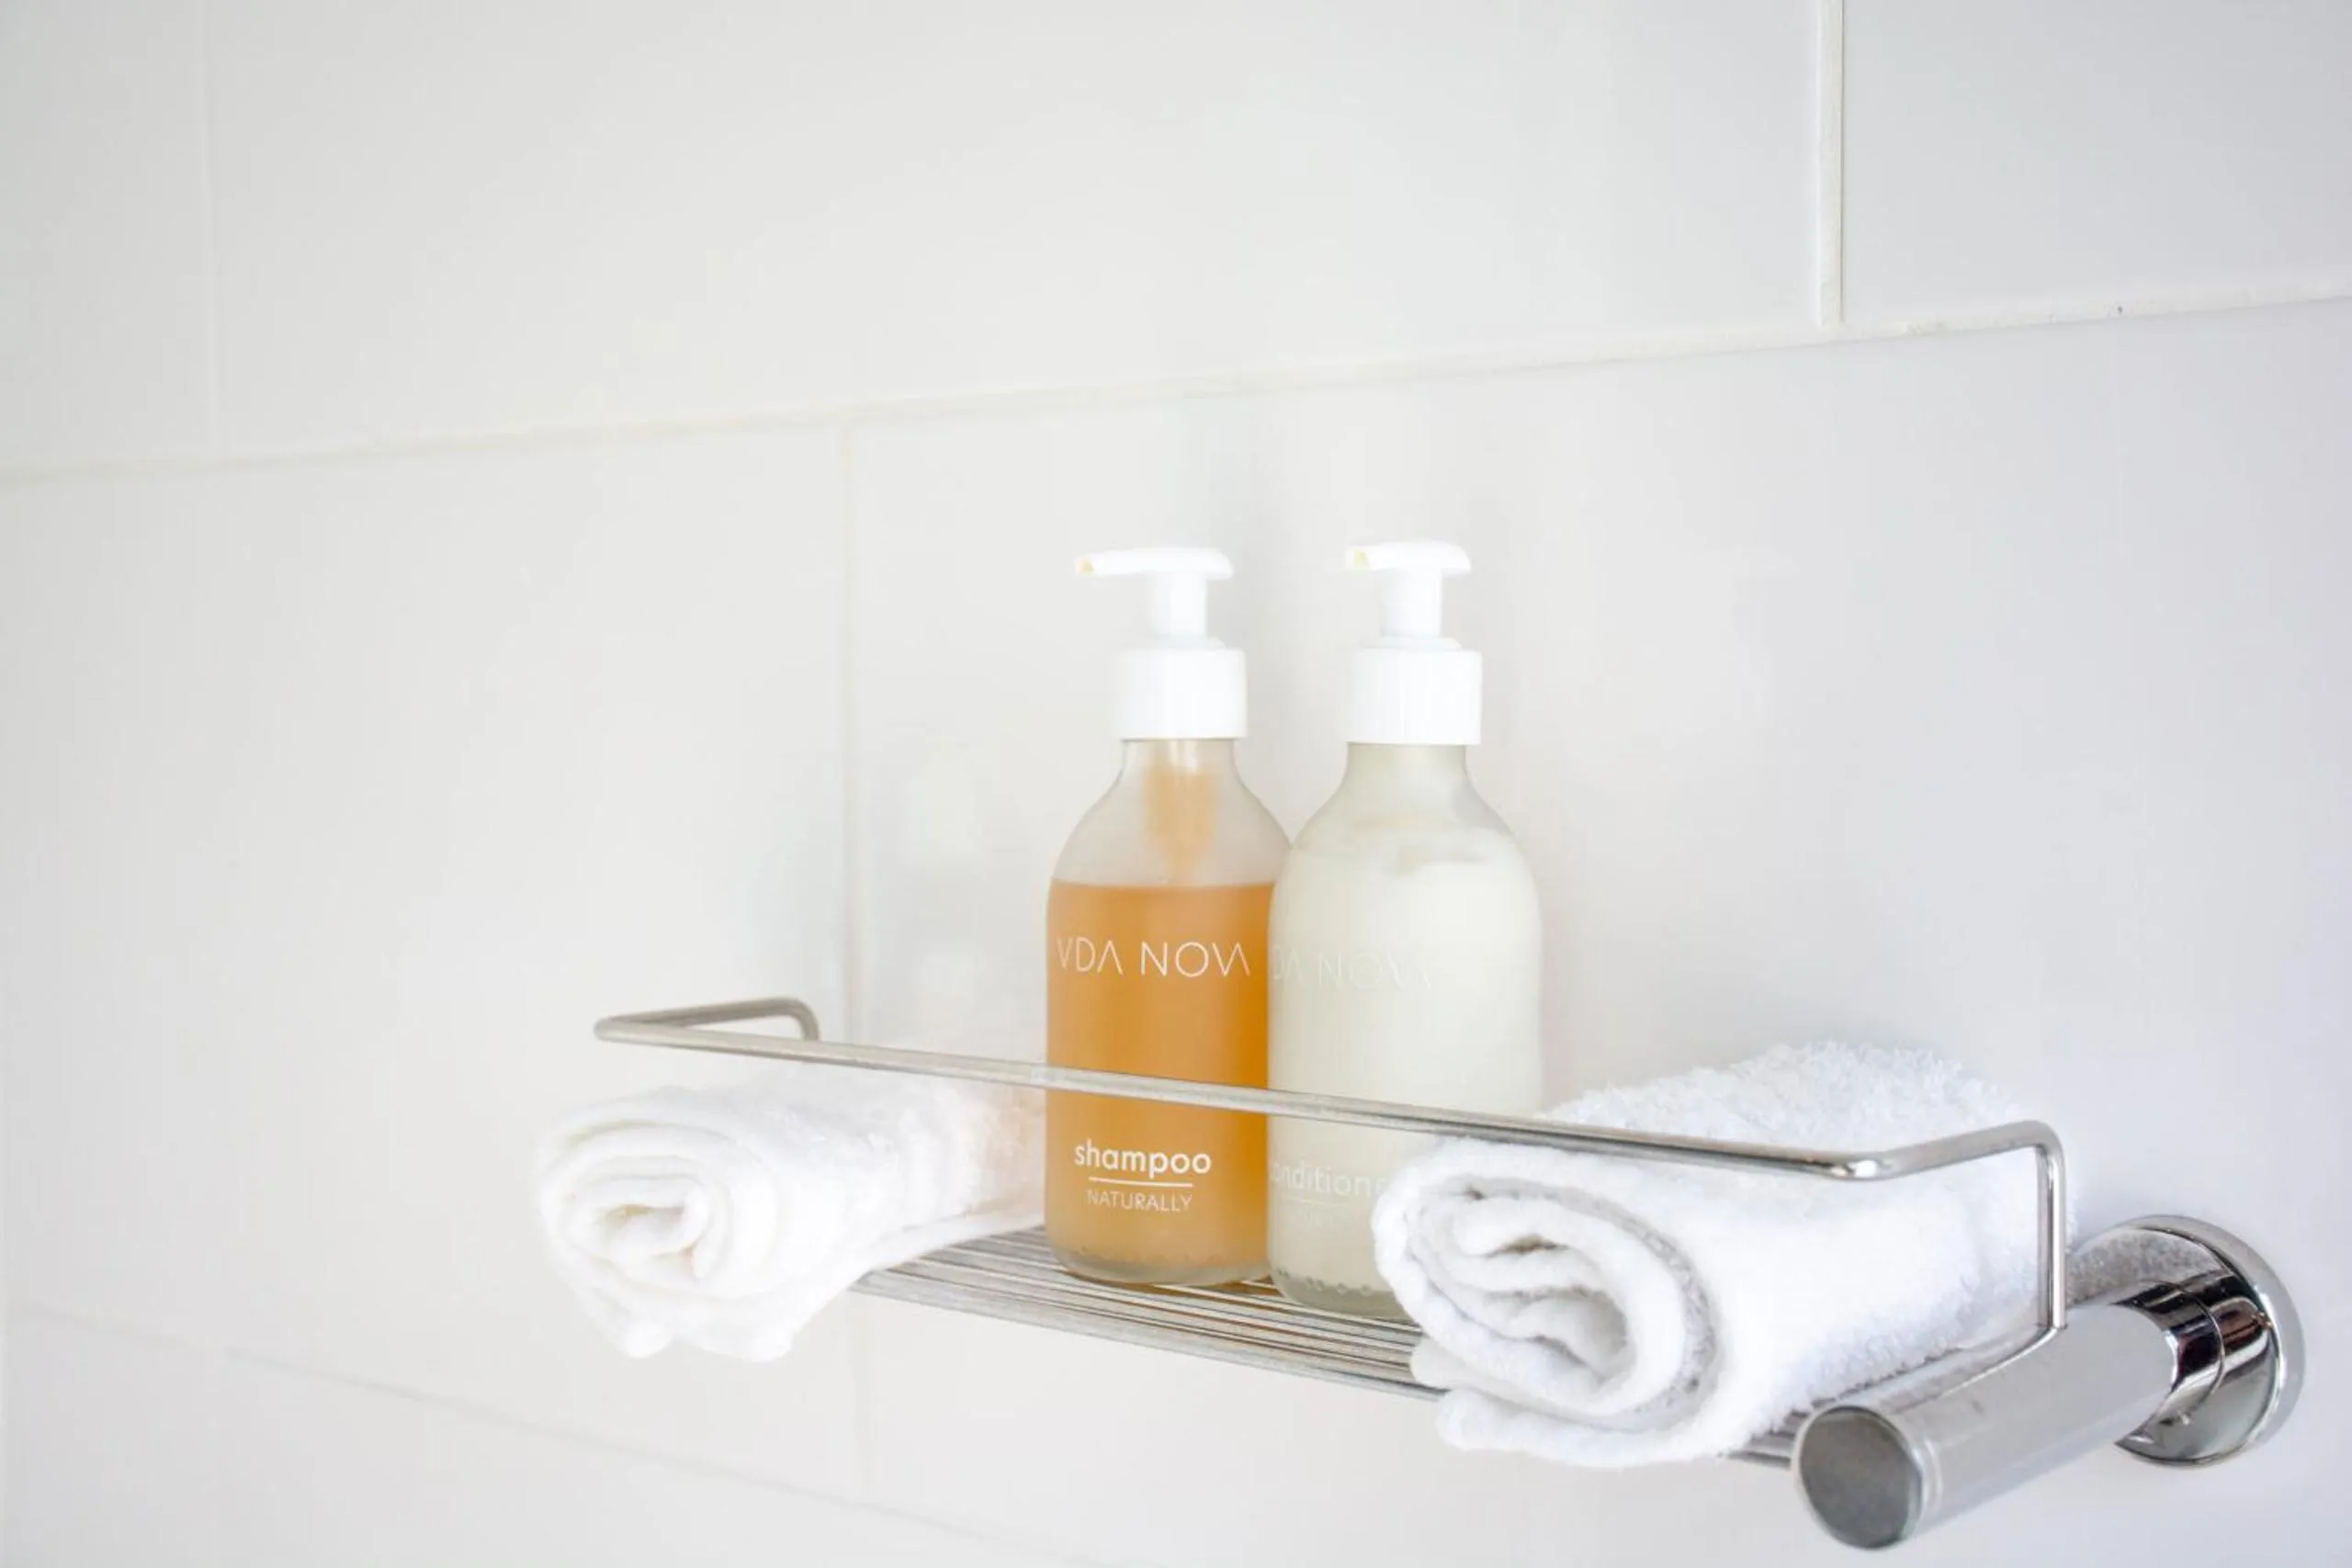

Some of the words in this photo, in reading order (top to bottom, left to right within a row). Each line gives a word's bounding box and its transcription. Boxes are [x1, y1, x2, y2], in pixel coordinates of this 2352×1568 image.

[1140, 941, 1250, 977] NOVA
[1272, 943, 1306, 985] DA
[1074, 1138, 1211, 1178] shampoo
[1086, 1190, 1193, 1212] NATURALLY
